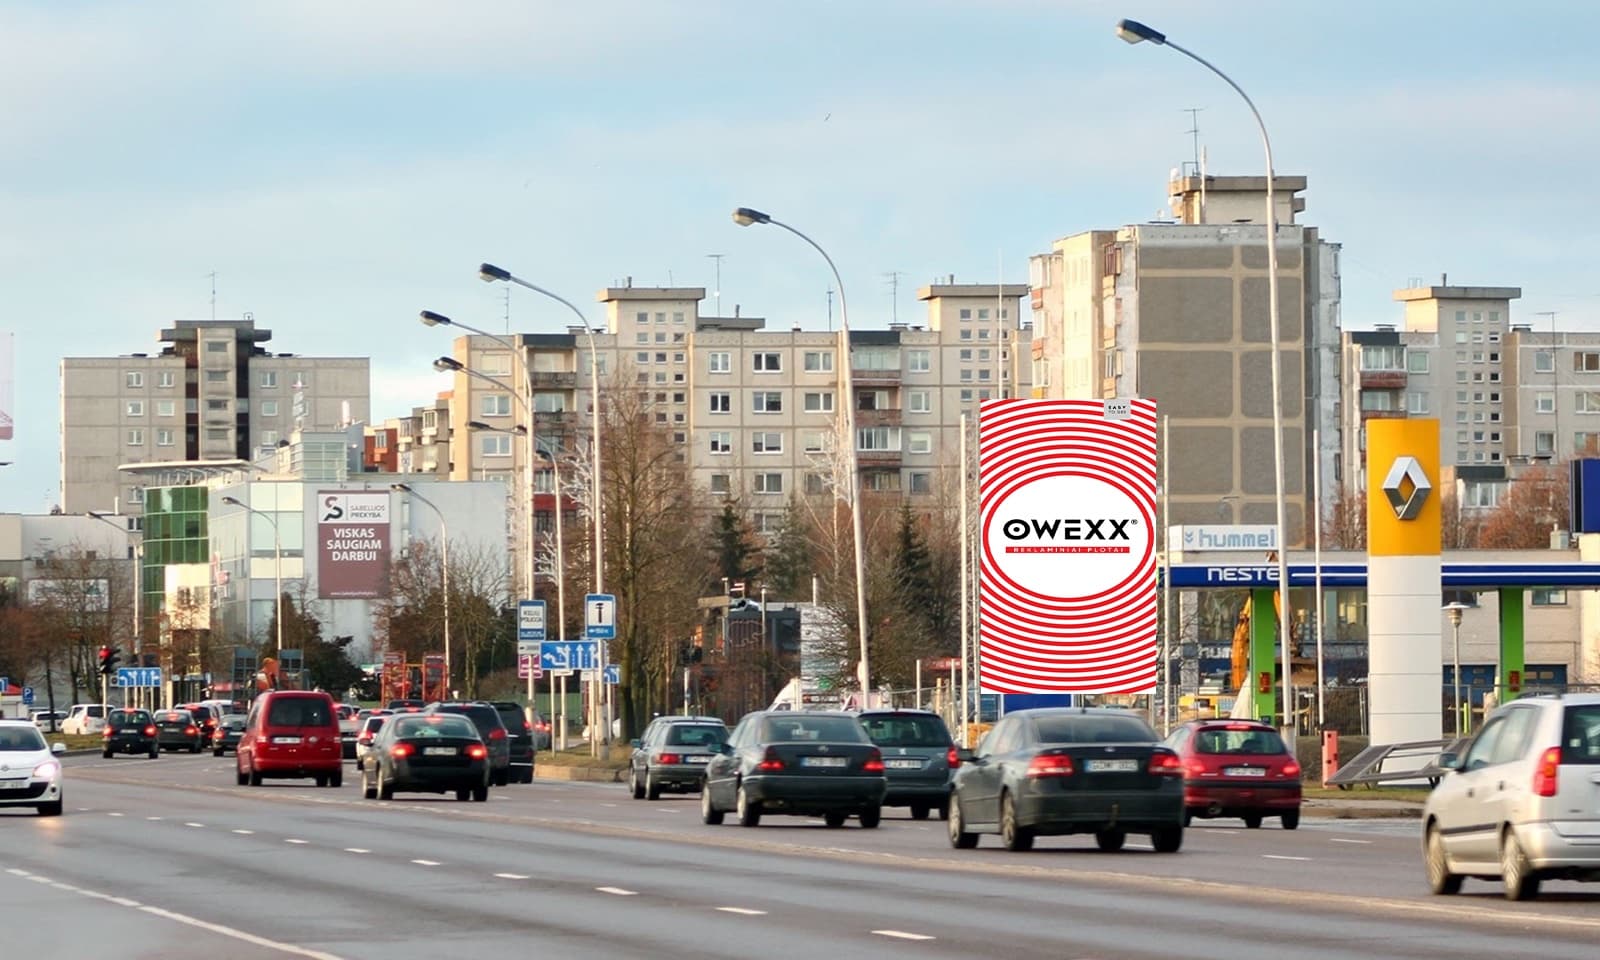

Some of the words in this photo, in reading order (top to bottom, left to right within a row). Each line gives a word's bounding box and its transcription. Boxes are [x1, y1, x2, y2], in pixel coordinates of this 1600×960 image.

[333, 528, 375, 538] VISKAS
[1199, 529, 1275, 547] hummel
[326, 539, 382, 550] SAUGIAM
[332, 551, 377, 561] DARBUI
[1207, 567, 1281, 581] NESTE
